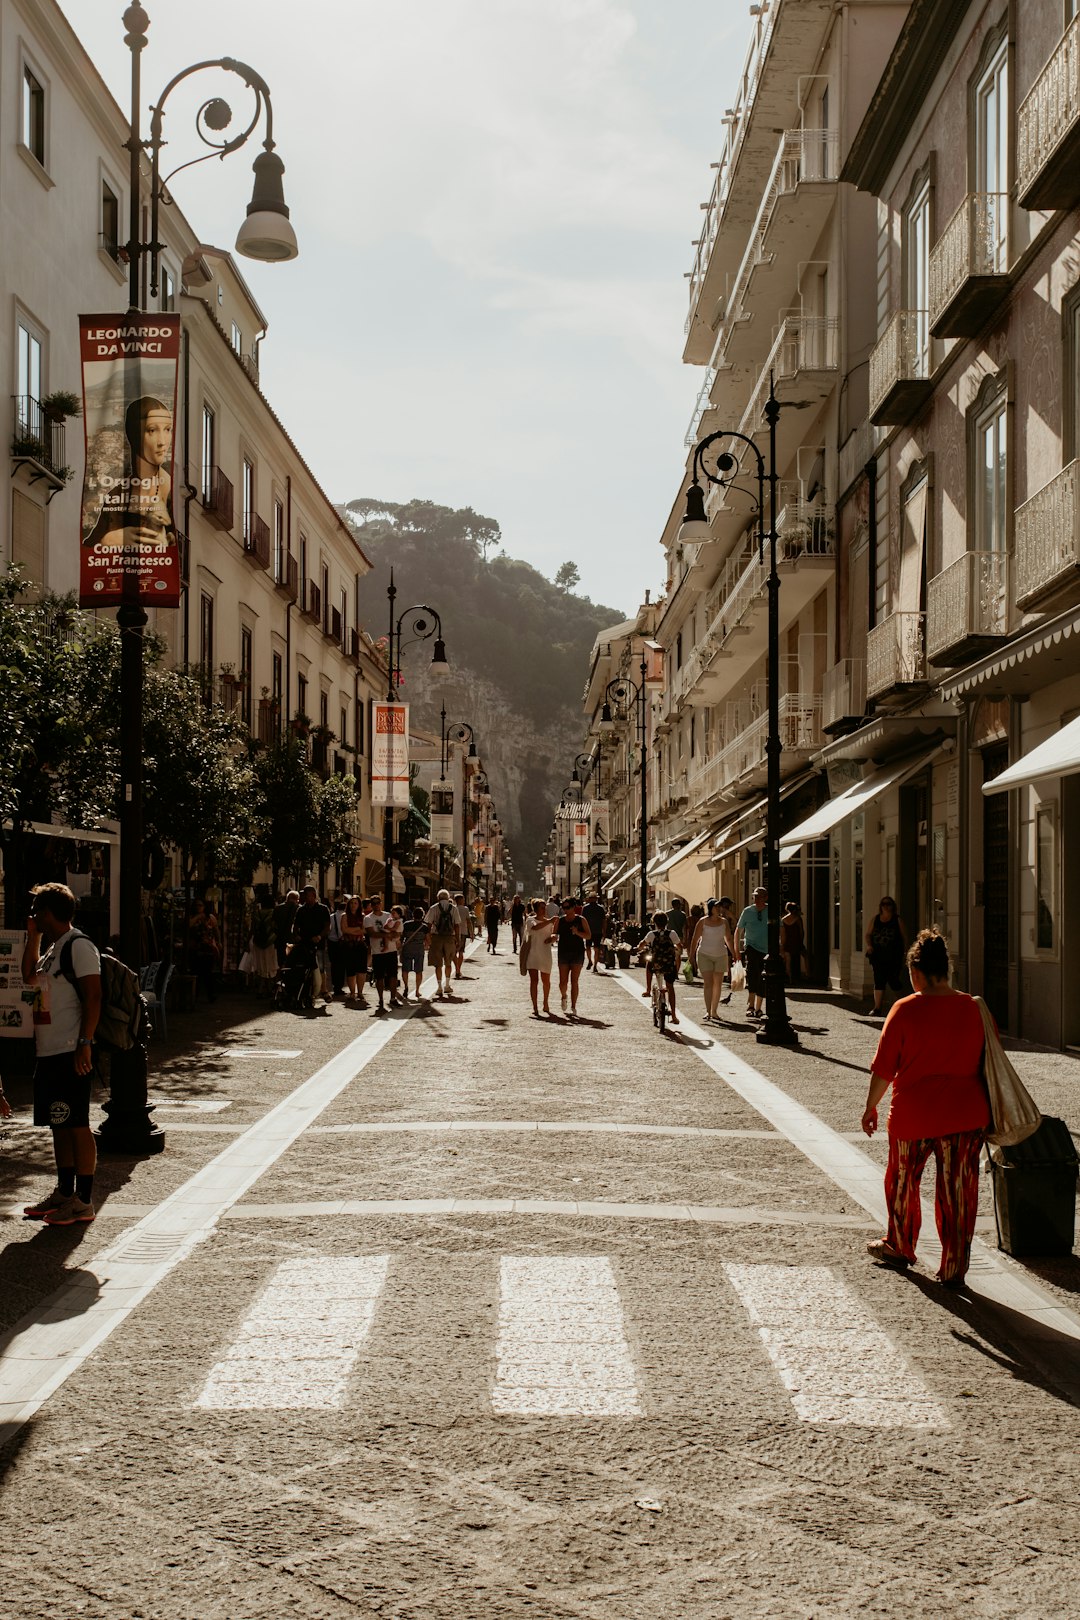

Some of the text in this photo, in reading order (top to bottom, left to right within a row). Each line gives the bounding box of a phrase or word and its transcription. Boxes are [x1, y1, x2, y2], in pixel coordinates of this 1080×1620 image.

[87, 327, 172, 340] LEONARDO
[97, 341, 162, 355] DA VINCI
[88, 475, 165, 490] L'Orgoglio
[98, 493, 160, 504] Italiano
[93, 543, 167, 554] Convento di
[88, 555, 173, 567] San Francesco
[125, 567, 153, 575] Gargiulo
